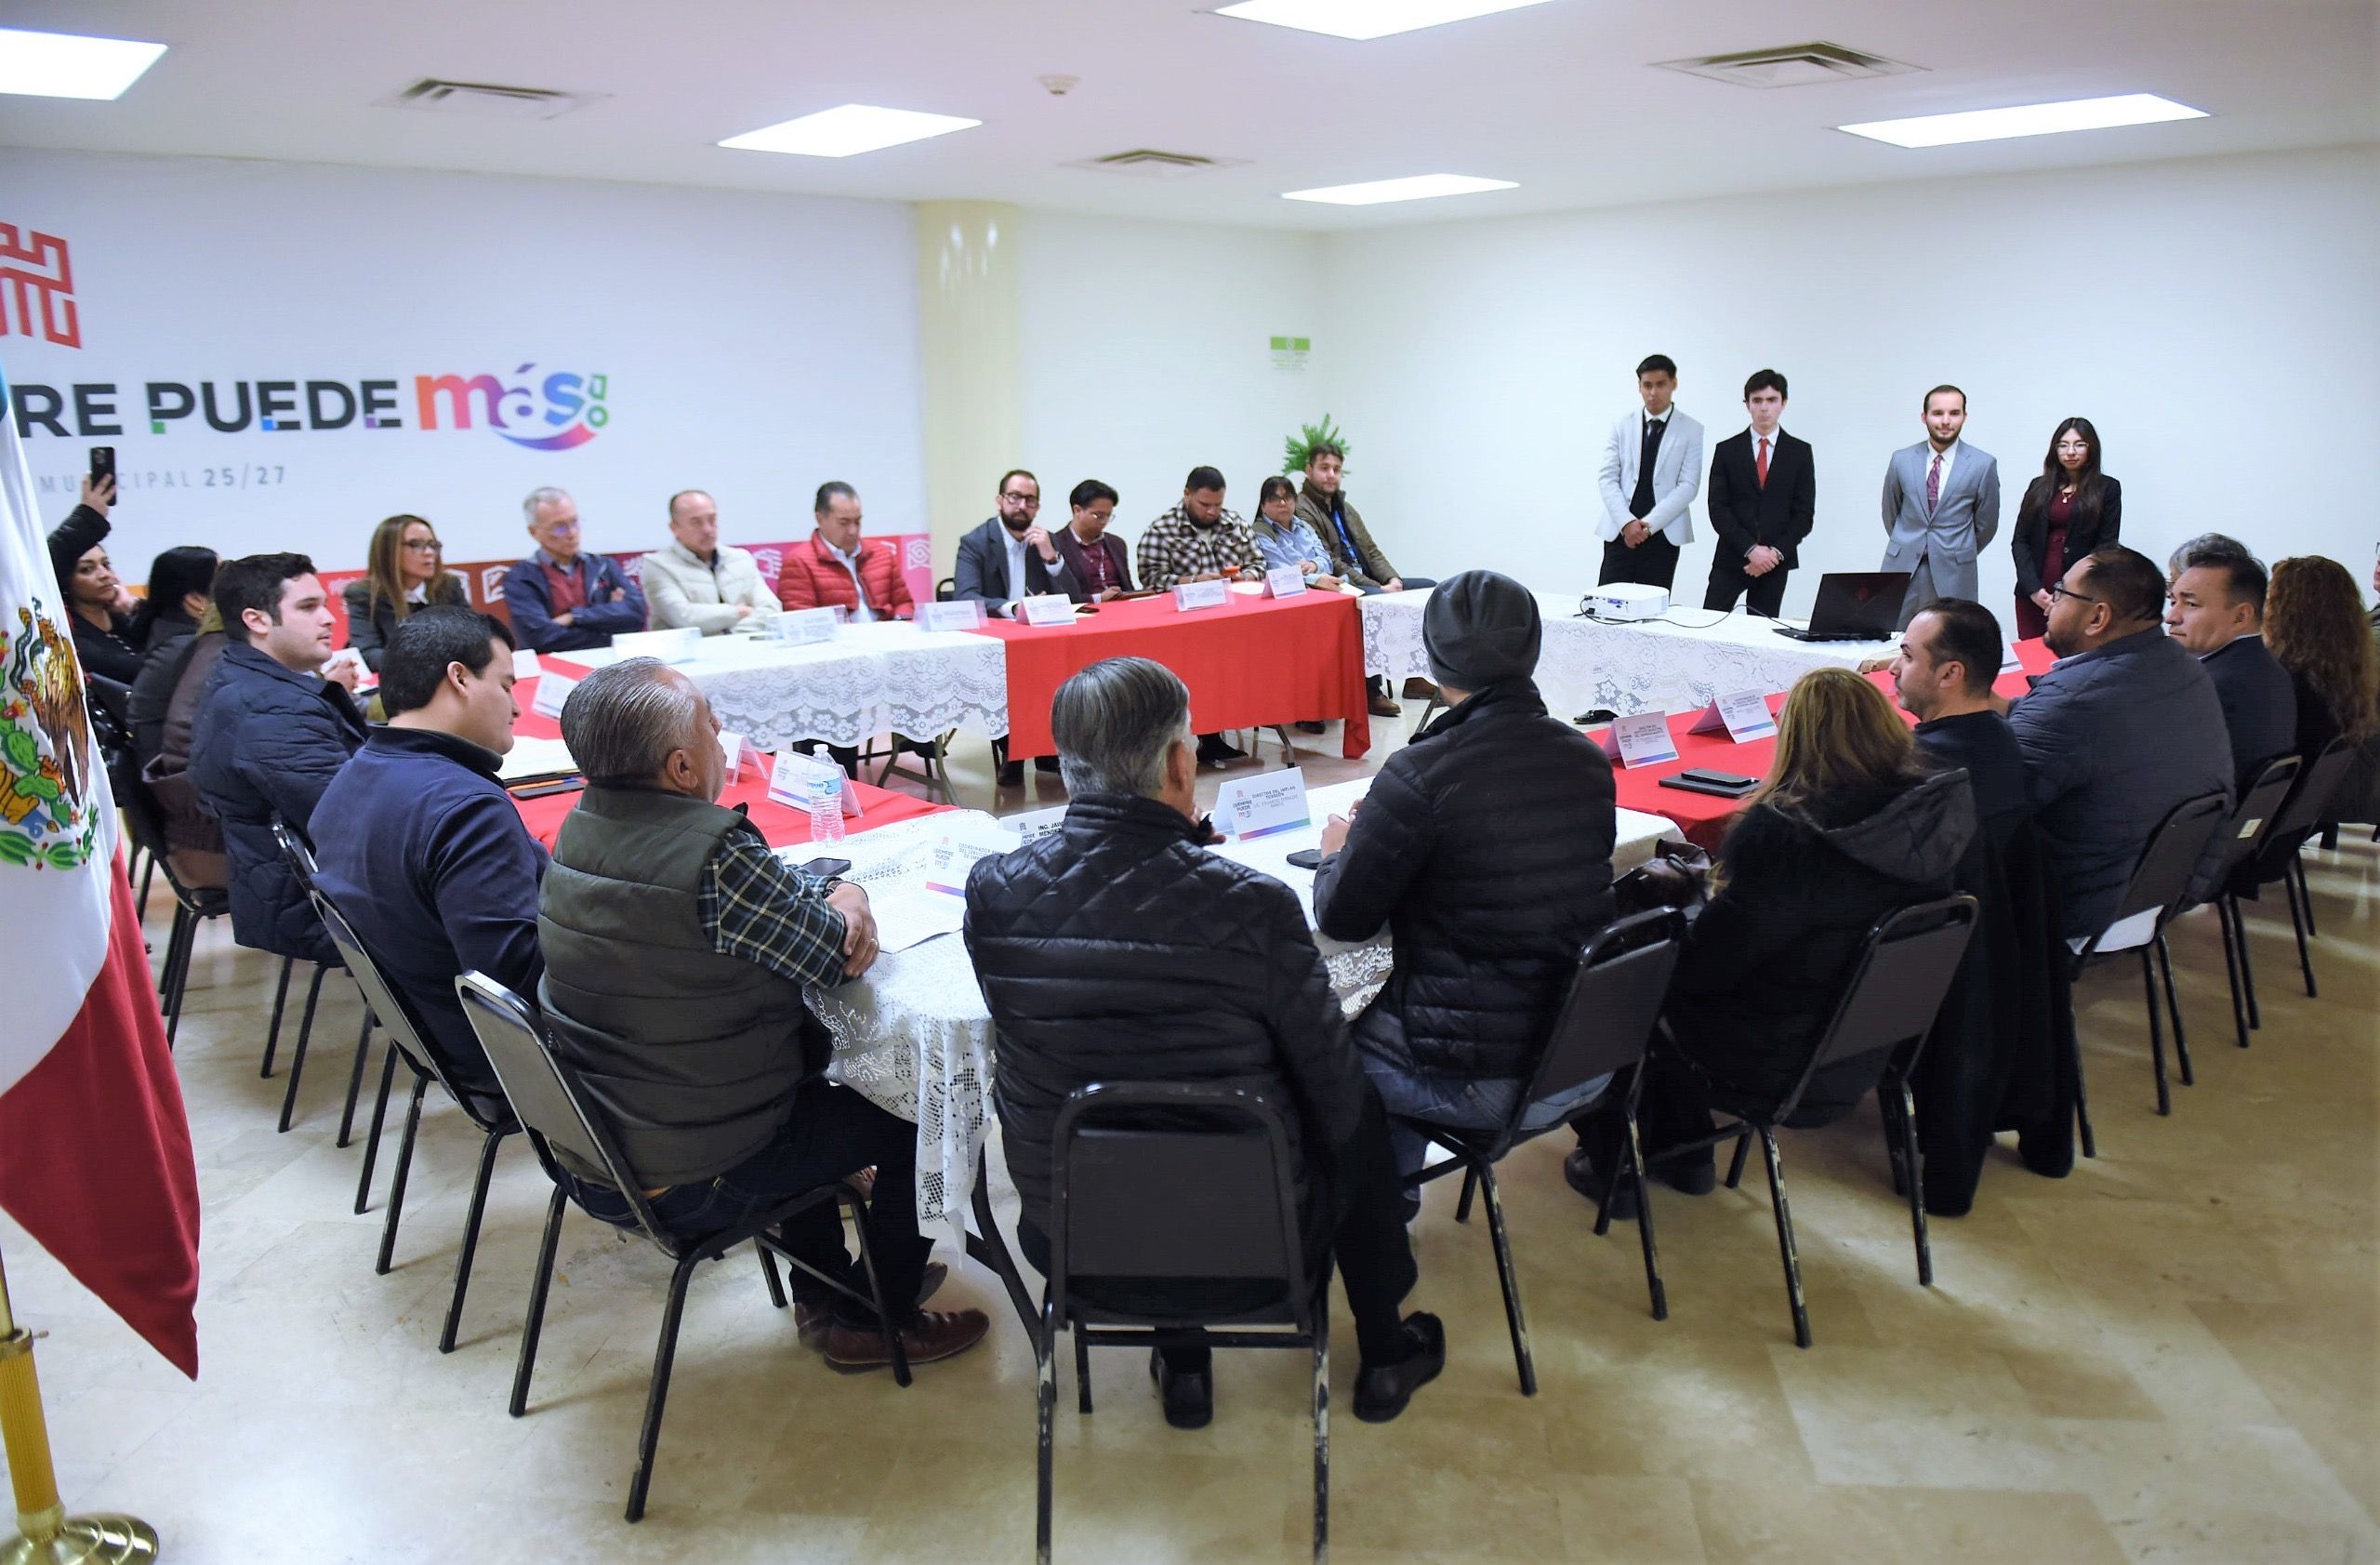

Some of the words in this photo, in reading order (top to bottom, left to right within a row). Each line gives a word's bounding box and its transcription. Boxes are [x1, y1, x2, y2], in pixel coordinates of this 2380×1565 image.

[145, 380, 403, 434] PUEDE
[38, 471, 192, 495] MUCIPAL
[203, 464, 285, 489] 25/27
